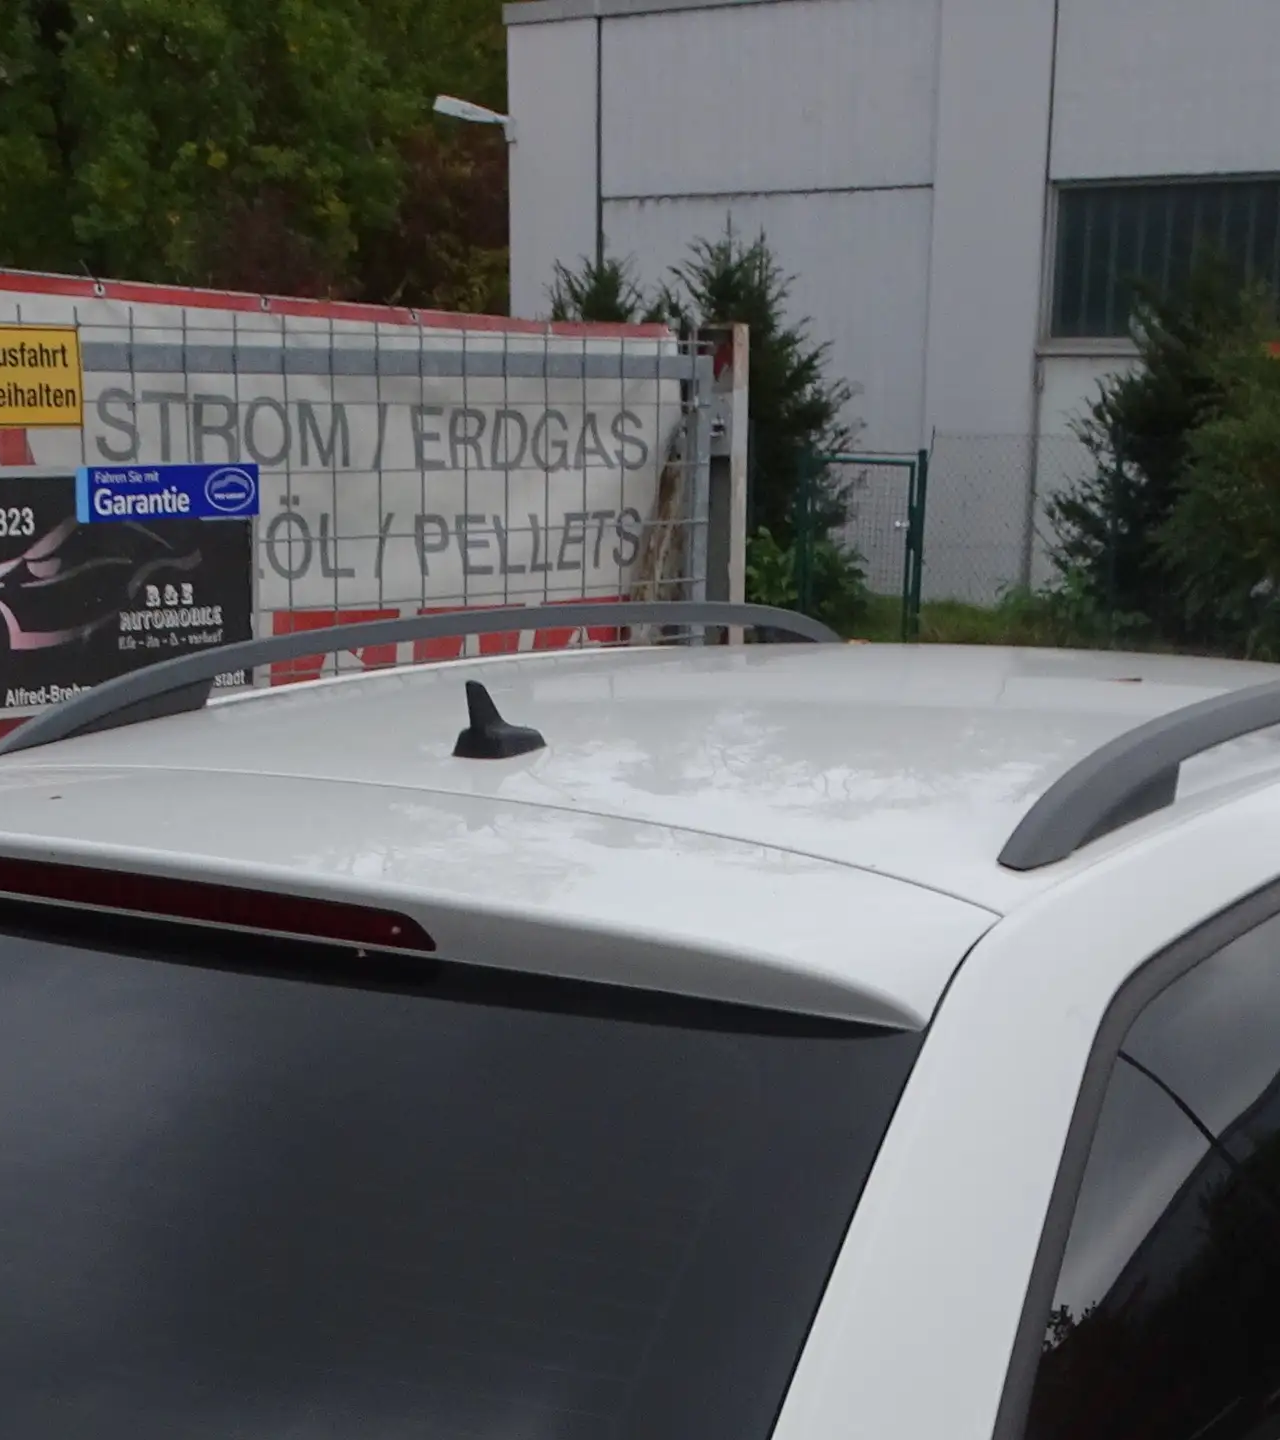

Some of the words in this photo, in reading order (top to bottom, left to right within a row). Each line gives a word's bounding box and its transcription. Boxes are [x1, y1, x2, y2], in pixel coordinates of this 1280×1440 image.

[96, 387, 350, 467] STROM
[410, 404, 648, 472] ERDGAS
[95, 471, 127, 484] Fahren
[129, 471, 143, 483] Sie
[144, 471, 160, 483] mit
[94, 486, 190, 516] Garantie
[260, 494, 355, 580] ÖL
[414, 507, 641, 577] PELLETS
[213, 669, 246, 687] stadt
[5, 683, 92, 707] Alfred-Breh
